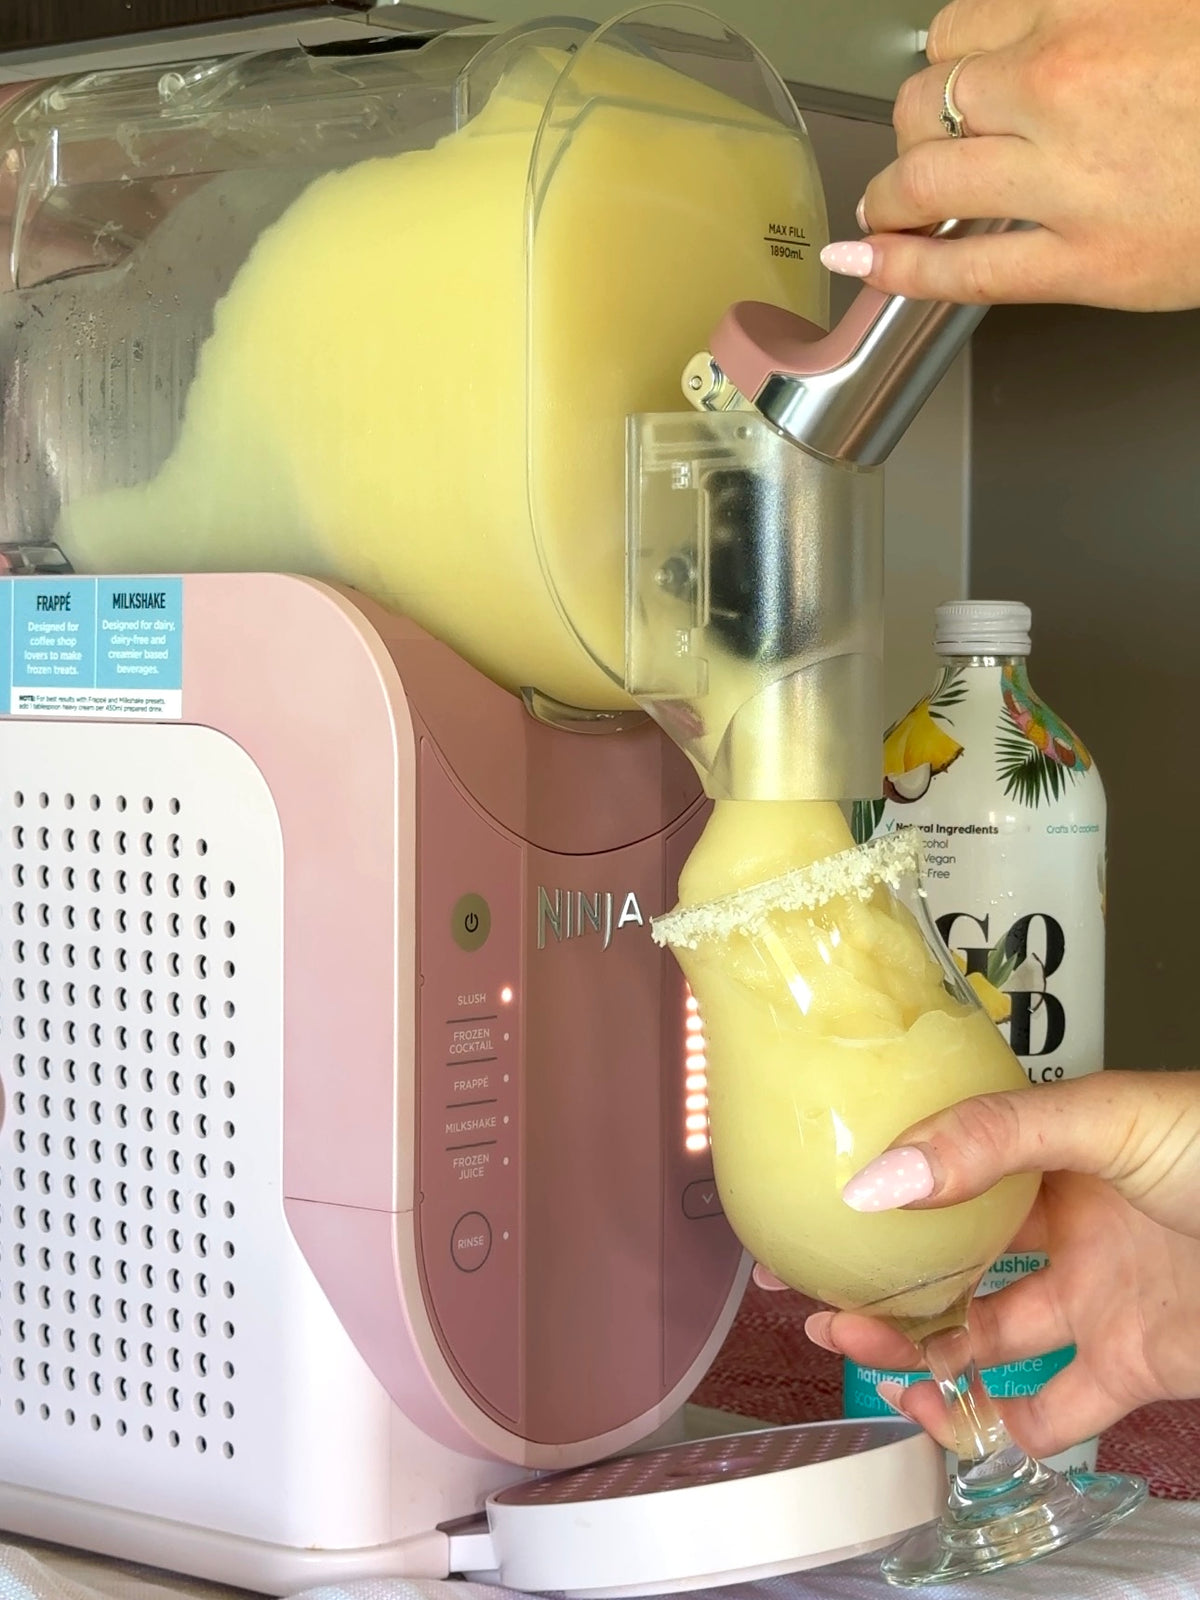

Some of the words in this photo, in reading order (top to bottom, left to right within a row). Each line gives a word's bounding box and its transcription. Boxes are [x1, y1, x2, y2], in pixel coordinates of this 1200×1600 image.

[768, 223, 788, 236] MAX
[789, 226, 806, 239] FILL
[770, 245, 804, 260] 1890mL
[37, 592, 71, 611] FRAPPÉ
[112, 592, 166, 609] MILKSHAKE
[28, 621, 65, 633] Designed
[67, 621, 79, 632] for
[102, 619, 139, 631] Designed
[140, 619, 152, 630] for
[30, 636, 55, 646] coffee
[57, 636, 76, 648] shop
[111, 635, 149, 646] dairy-free
[151, 635, 166, 645] and
[24, 650, 48, 660] lovers
[50, 651, 58, 660] to
[60, 650, 82, 661] make
[144, 649, 168, 660] based
[27, 664, 52, 675] frozen
[54, 665, 79, 676] treats.
[117, 663, 159, 676] beverages.
[936, 824, 999, 836] Ingredients
[923, 854, 956, 865] Vegan
[537, 886, 644, 952] NINJA
[457, 993, 487, 1006] SLUSH
[453, 1028, 490, 1041] FROZEN
[449, 1041, 494, 1054] COCKTAIL
[454, 1075, 489, 1091] FRAPPÉ
[445, 1116, 497, 1134] MILKSHAKE
[453, 1153, 490, 1169] FROZEN
[459, 1167, 485, 1180] JUICE
[457, 1235, 484, 1249] RINSE
